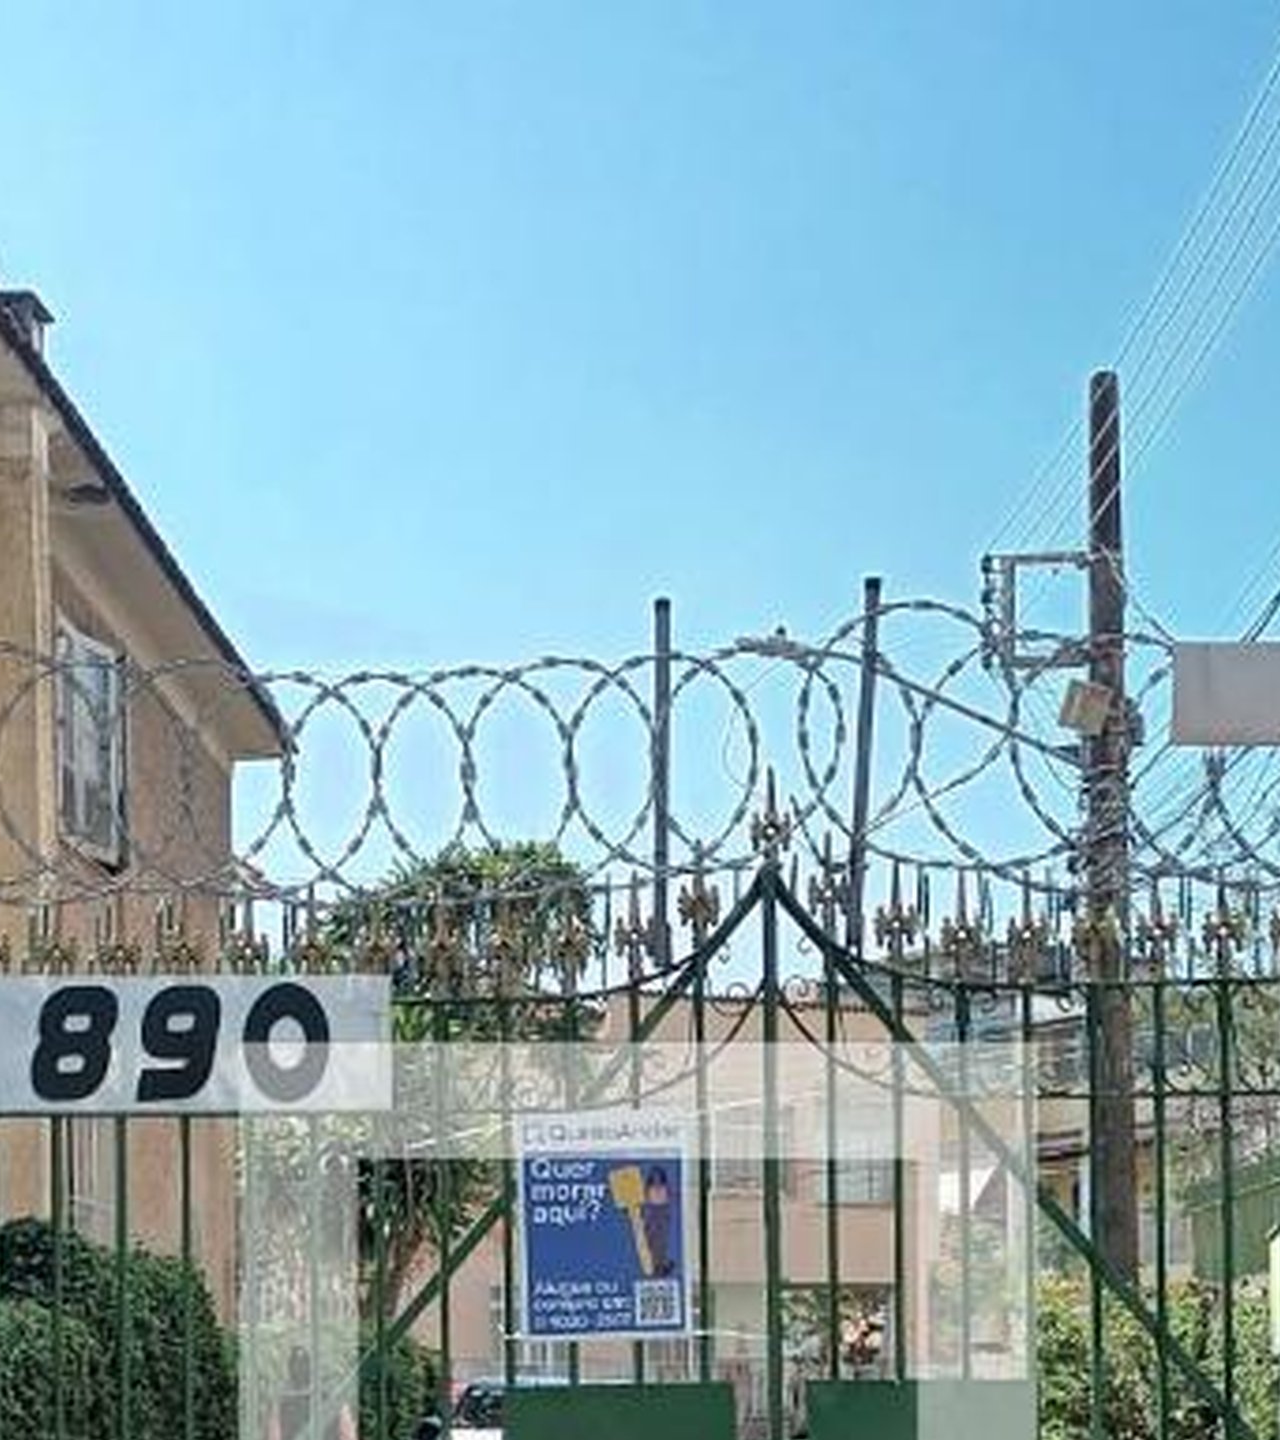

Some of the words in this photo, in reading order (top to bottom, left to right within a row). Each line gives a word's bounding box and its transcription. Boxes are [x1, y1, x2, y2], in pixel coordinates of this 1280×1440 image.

[30, 982, 330, 1103] 890
[530, 1158, 595, 1179] Quer
[532, 1201, 602, 1229] aqui?
